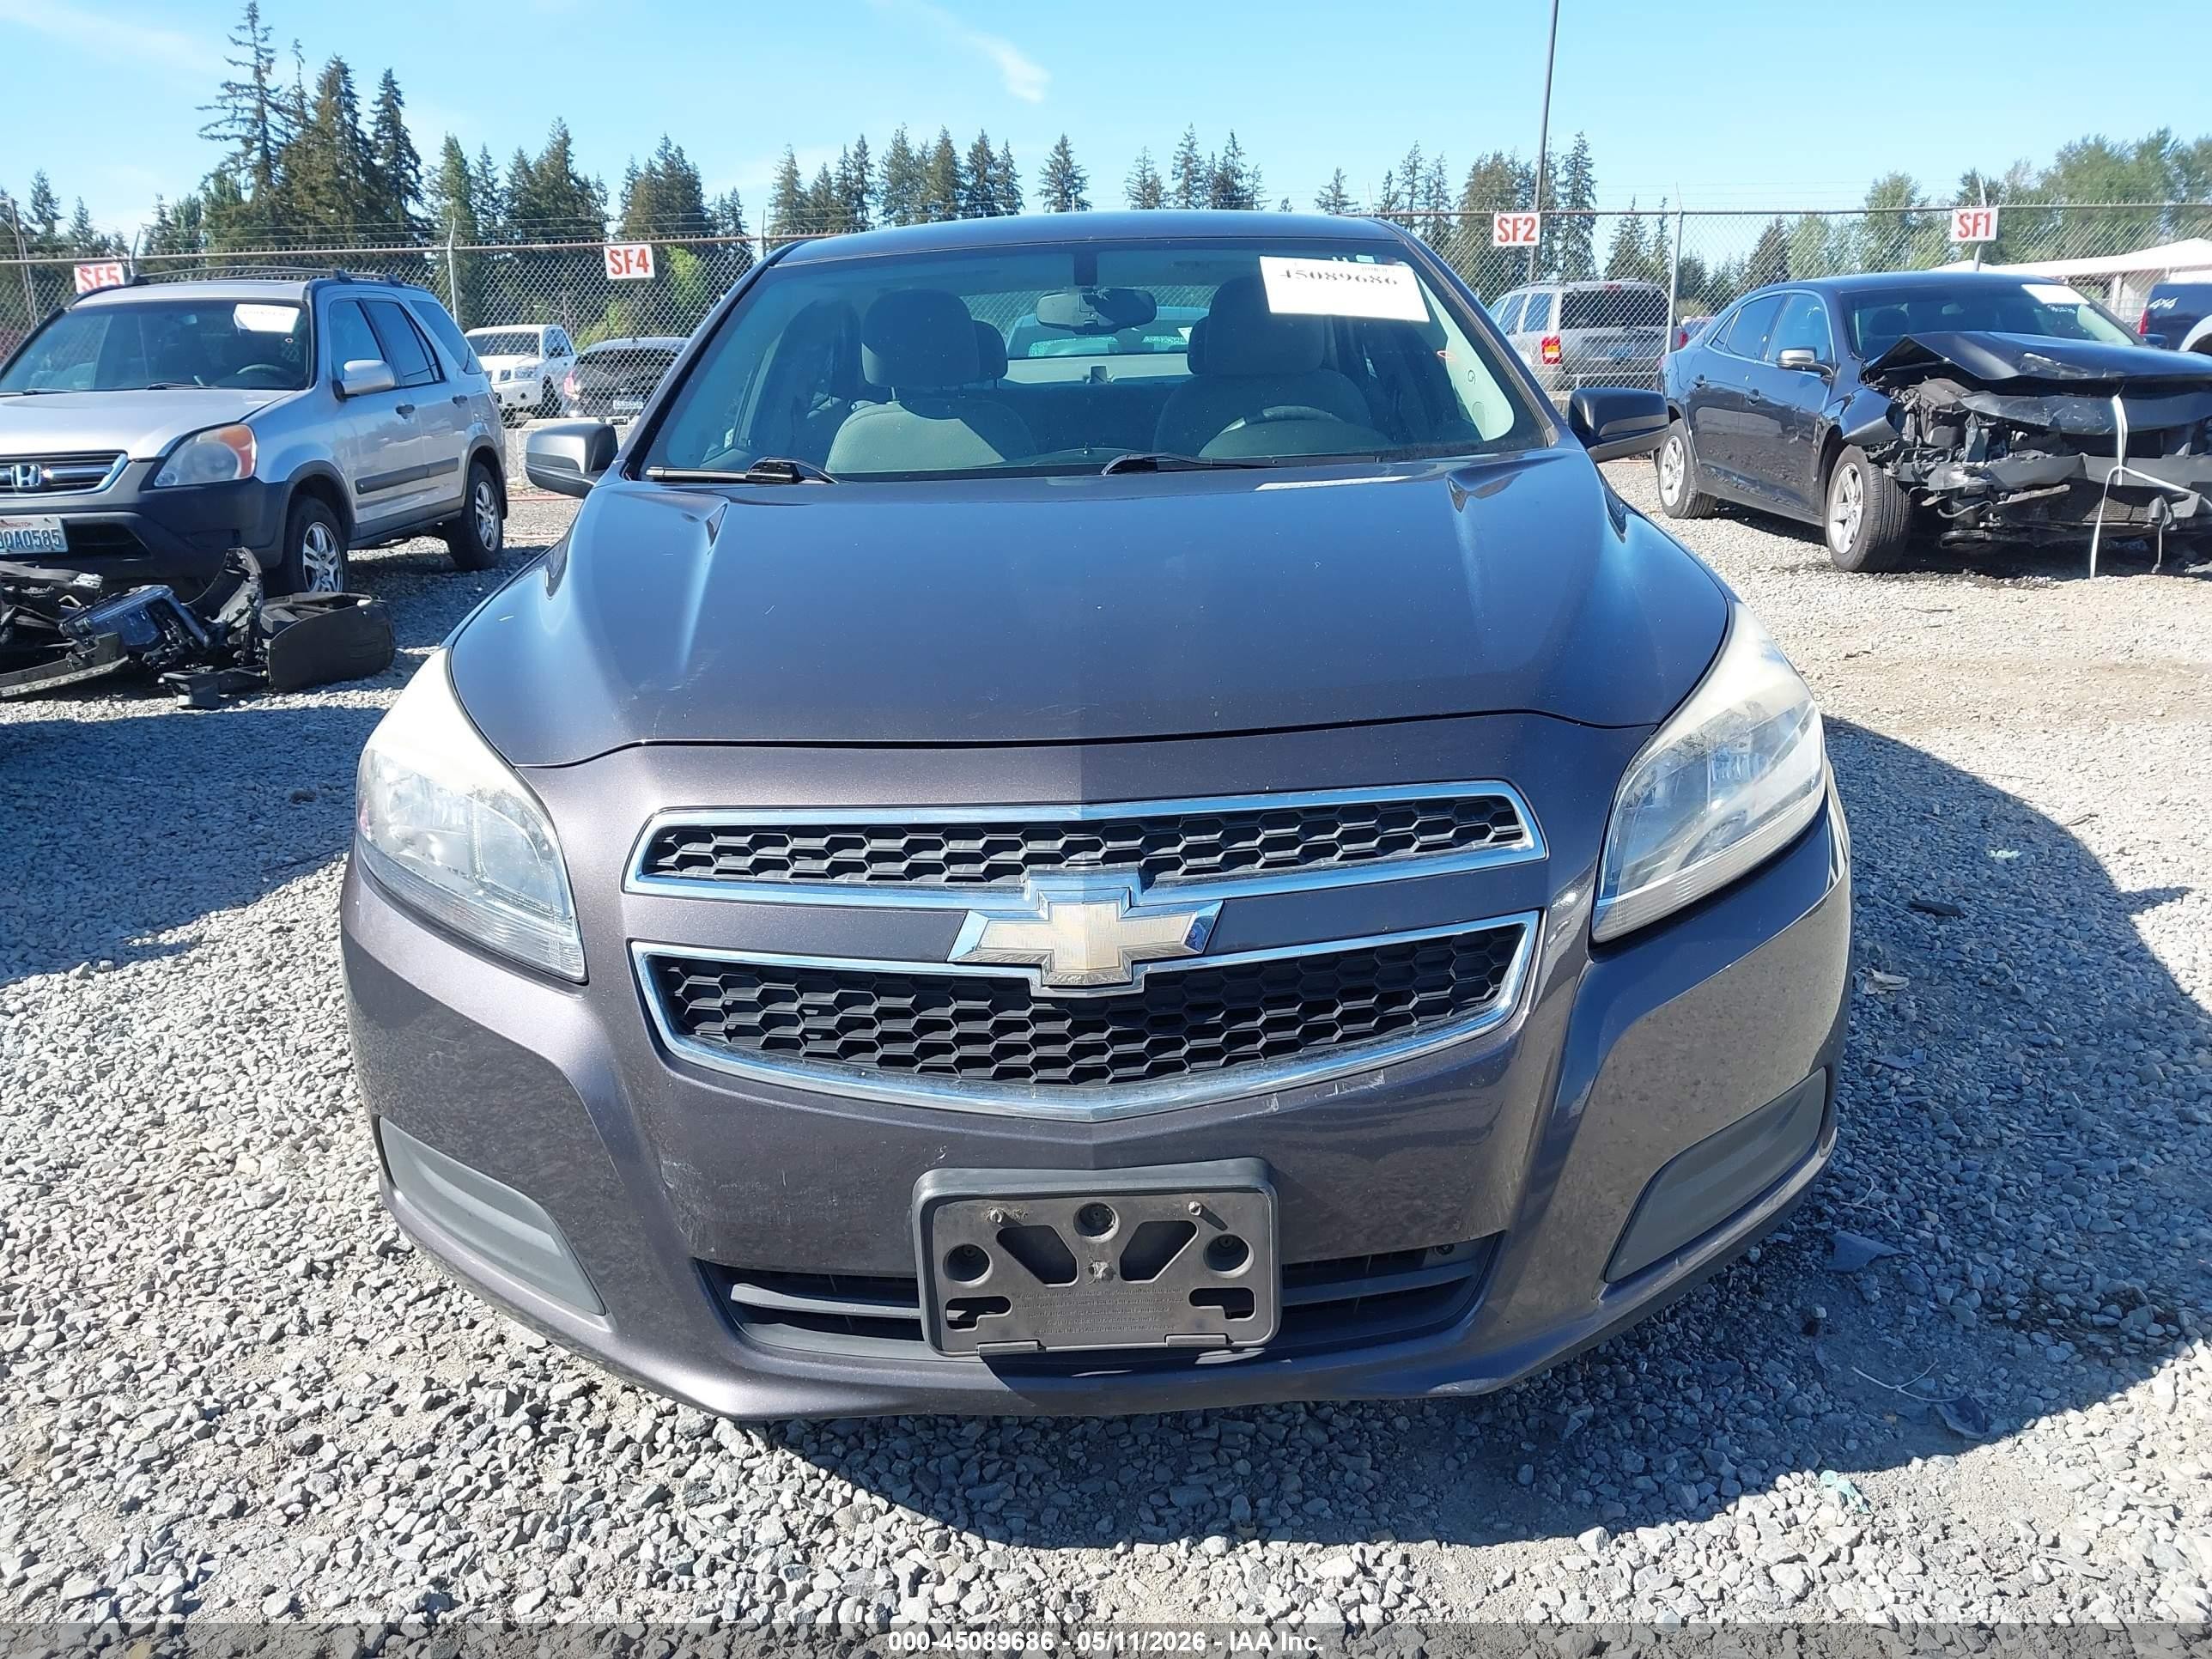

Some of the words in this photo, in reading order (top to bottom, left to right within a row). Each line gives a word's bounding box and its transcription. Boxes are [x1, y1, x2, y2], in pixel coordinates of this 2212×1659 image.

[1498, 216, 1536, 242] SF2
[1958, 211, 1991, 238] SF1
[609, 248, 650, 275] SF4
[78, 264, 120, 290] SF5
